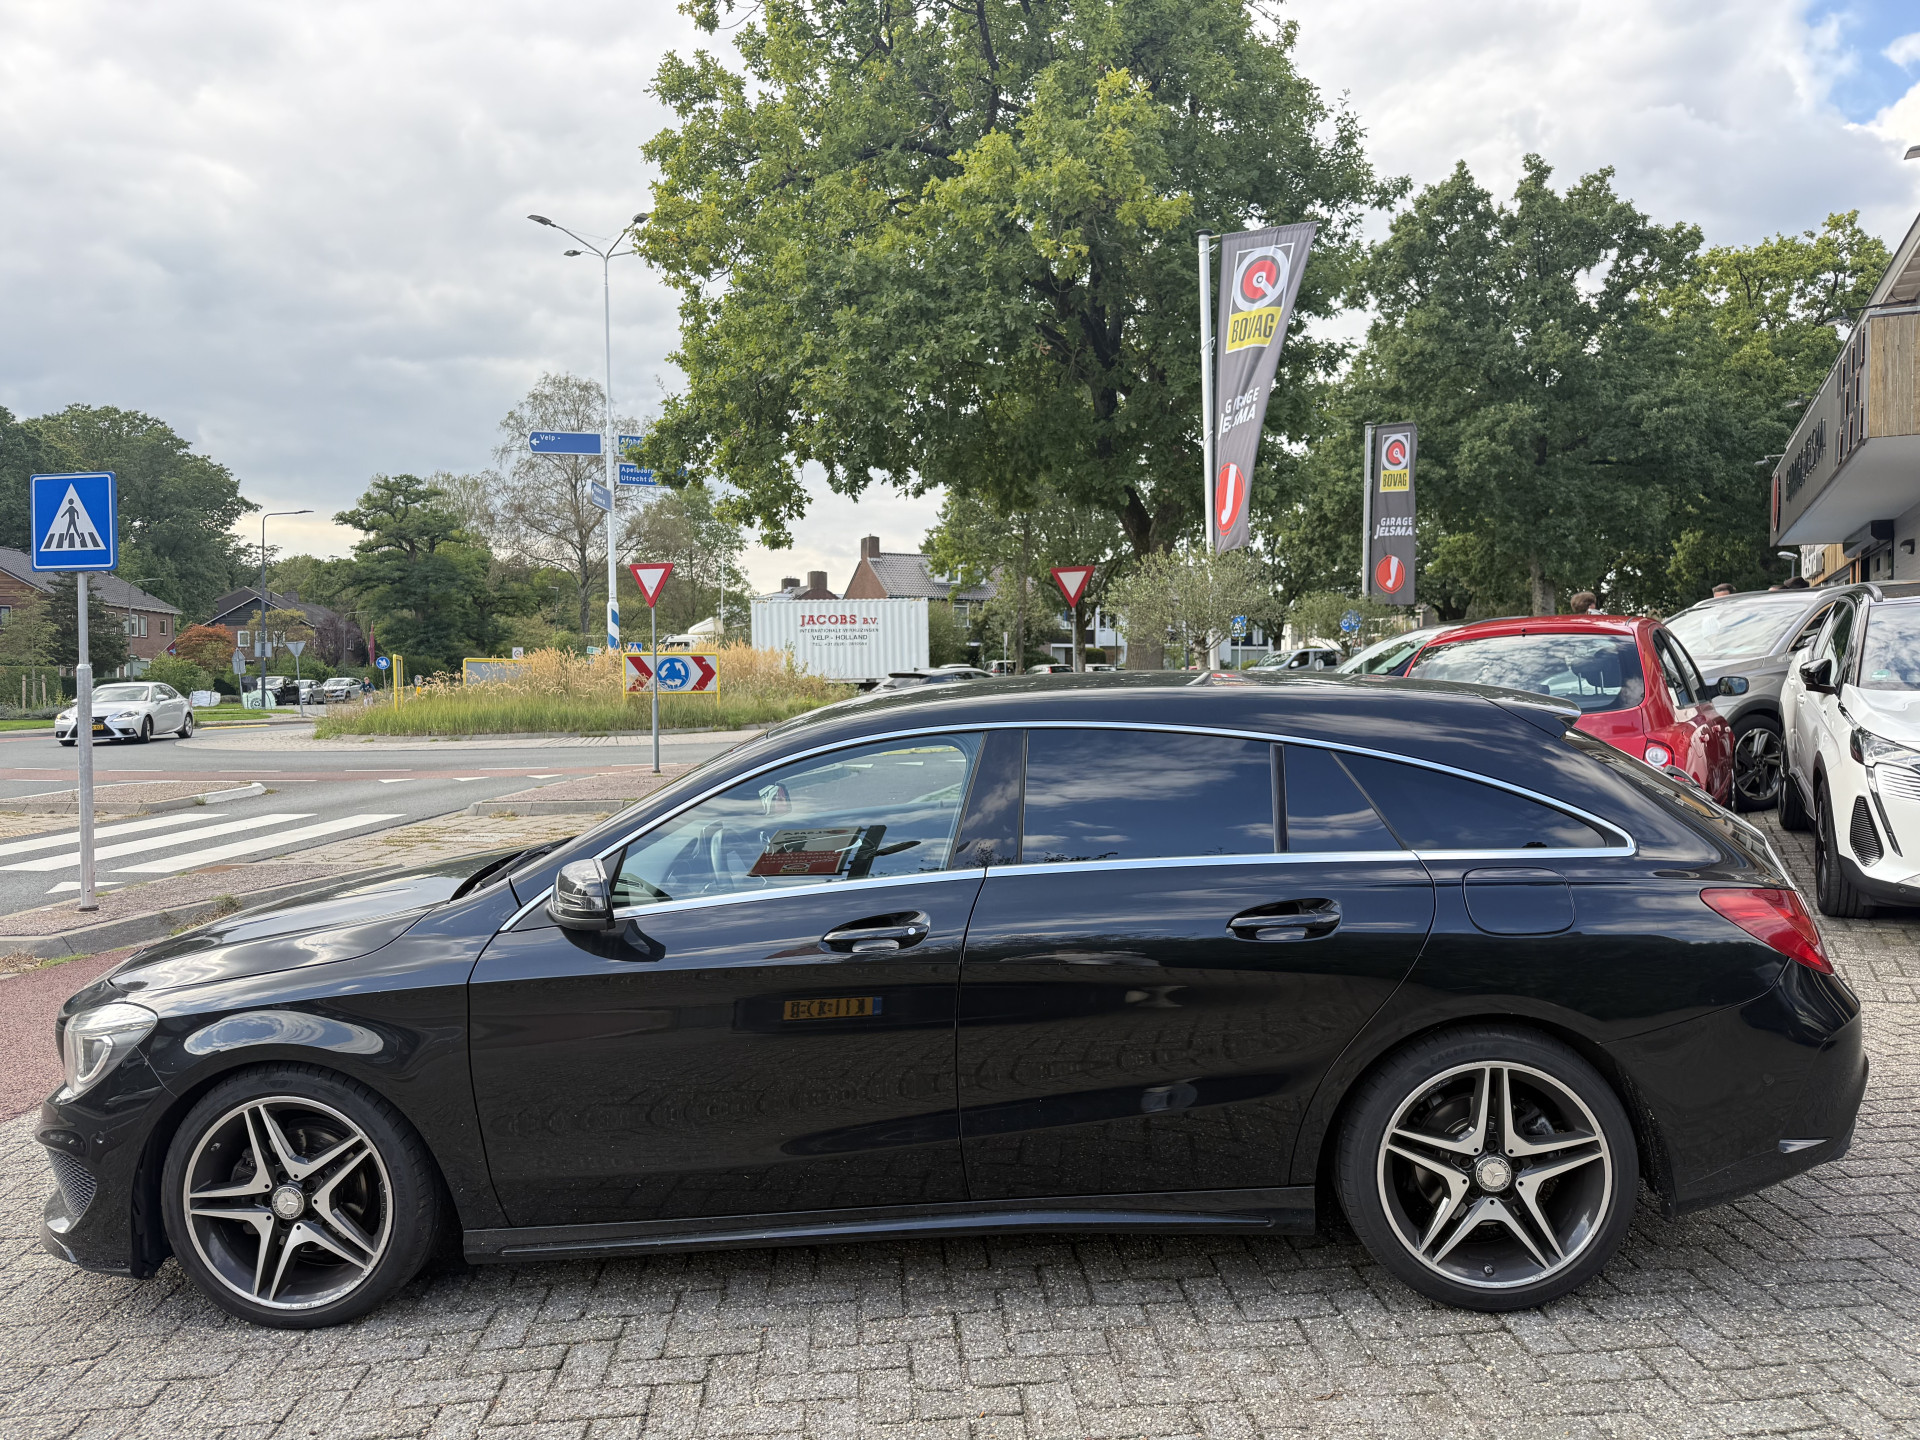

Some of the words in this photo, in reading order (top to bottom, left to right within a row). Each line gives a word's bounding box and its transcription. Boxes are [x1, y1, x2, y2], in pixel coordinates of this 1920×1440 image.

[1231, 313, 1275, 343] BOVAG
[539, 434, 556, 442] Velp
[620, 474, 647, 482] Utrecht
[1382, 472, 1407, 487] BOVAG
[1374, 524, 1413, 540] JELSMA
[800, 614, 857, 627] JACOBS
[862, 617, 879, 625] B.V.
